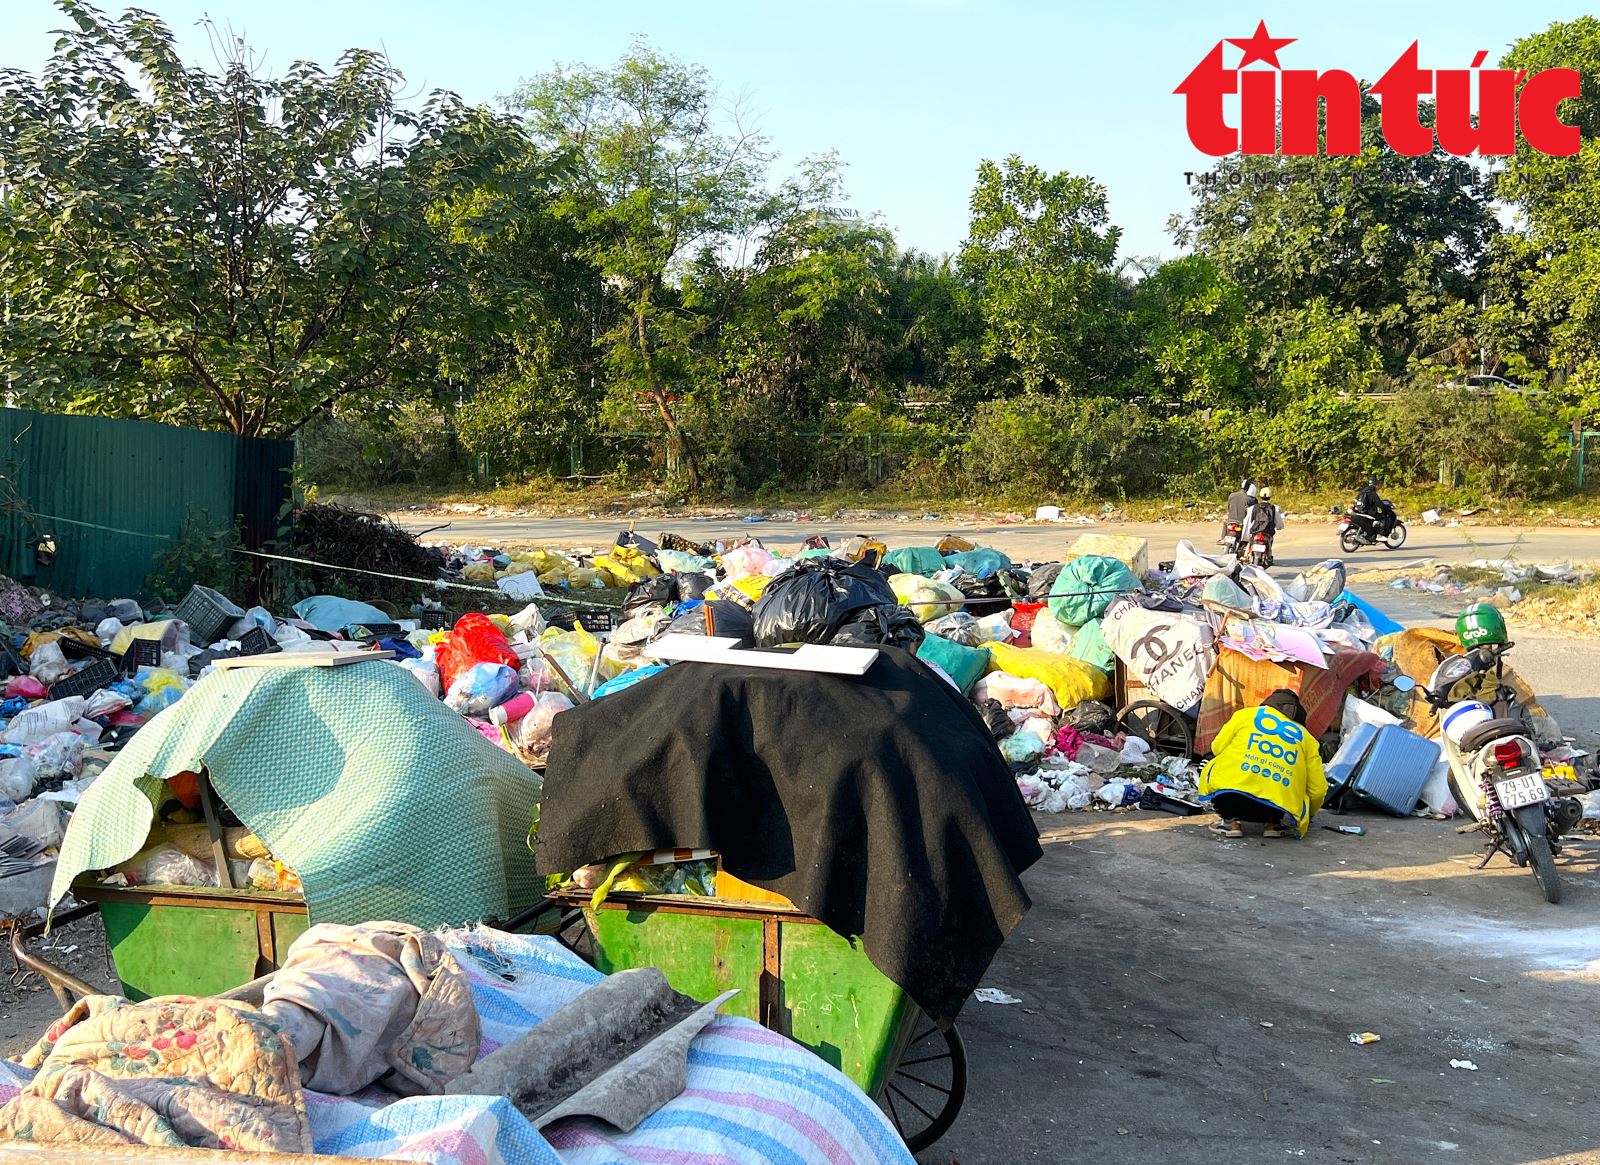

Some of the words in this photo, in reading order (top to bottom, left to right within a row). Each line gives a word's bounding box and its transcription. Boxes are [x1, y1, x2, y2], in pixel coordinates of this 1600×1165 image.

[1463, 627, 1488, 640] Grab
[1254, 708, 1303, 744] be
[1247, 733, 1298, 765] Food
[1503, 776, 1536, 793] 29-U1
